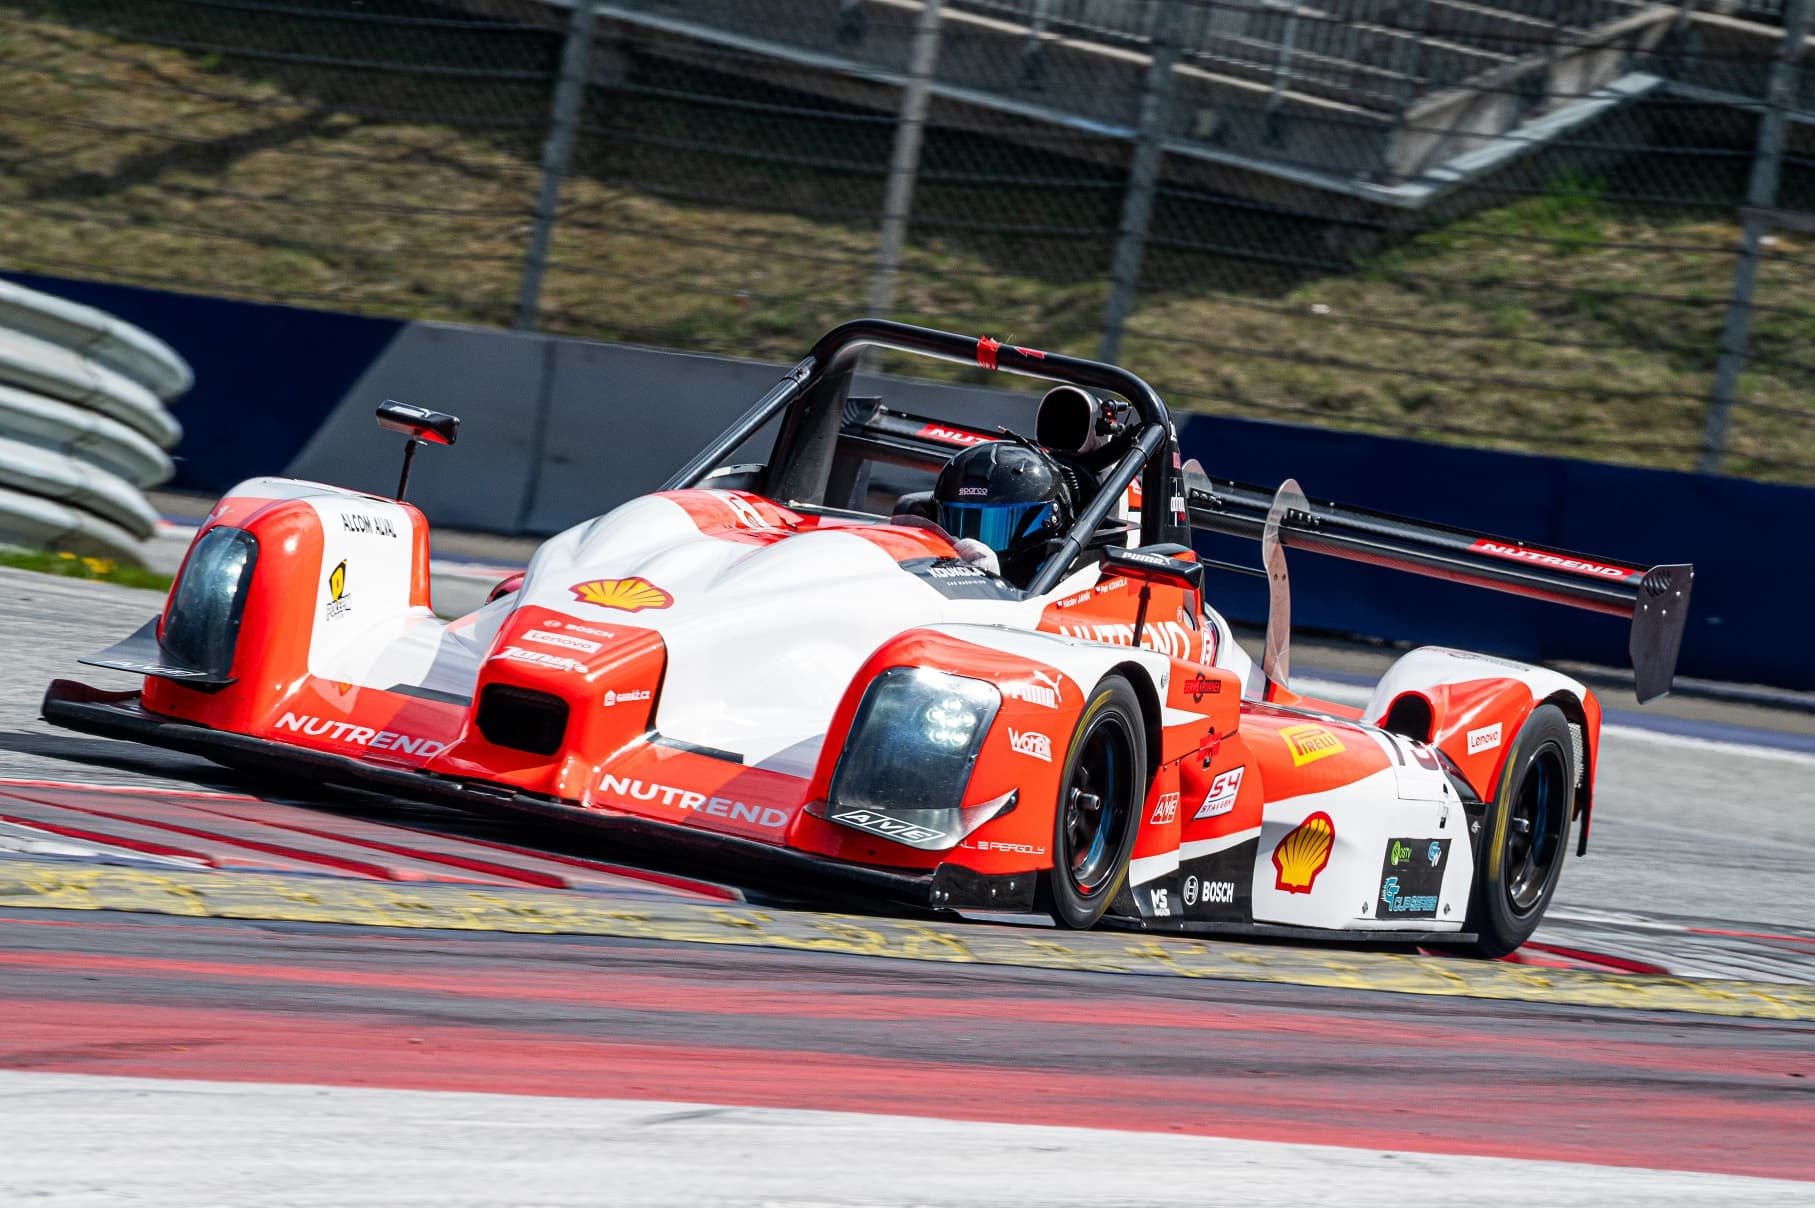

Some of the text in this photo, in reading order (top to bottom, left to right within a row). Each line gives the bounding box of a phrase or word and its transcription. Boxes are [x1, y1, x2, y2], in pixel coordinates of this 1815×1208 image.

[959, 487, 988, 496] sparco
[340, 512, 374, 534] ALCOM
[1480, 542, 1624, 577] NUTREND
[530, 632, 593, 650] Lenovo
[564, 623, 615, 639] BOSCH
[275, 711, 446, 758] NUTREND
[1292, 728, 1337, 757] PIRELLI
[1470, 731, 1499, 748] Lenovo
[598, 774, 788, 828] NUTREND
[840, 812, 936, 841] AVE
[1150, 888, 1168, 909] MS
[1202, 881, 1235, 903] BOSCH
